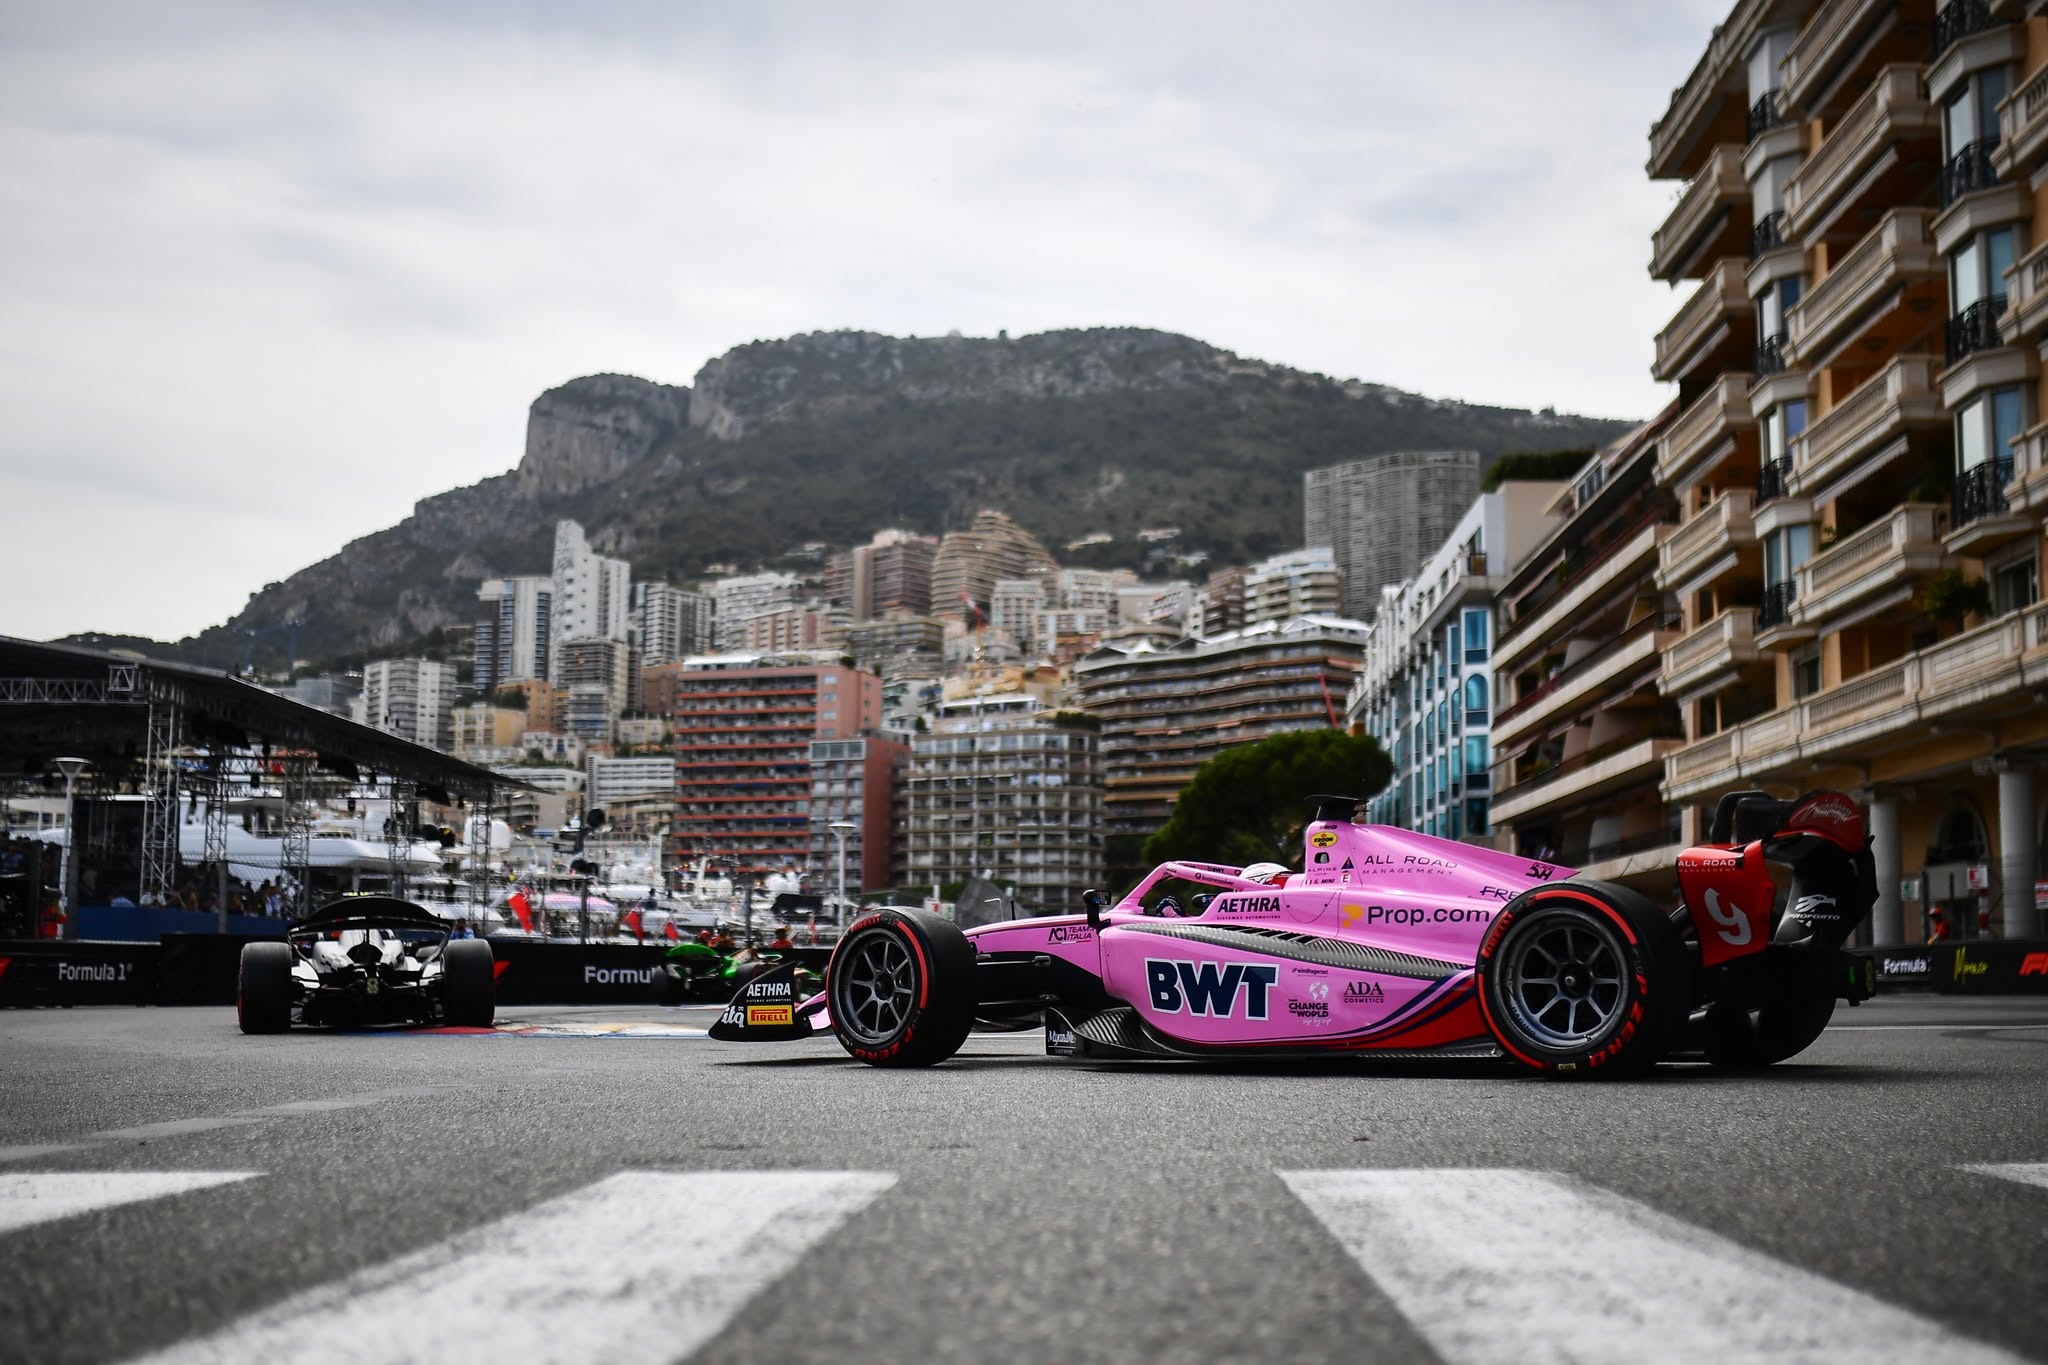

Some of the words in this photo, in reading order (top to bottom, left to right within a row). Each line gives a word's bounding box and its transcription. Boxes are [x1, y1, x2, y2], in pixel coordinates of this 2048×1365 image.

[1364, 855, 1394, 865] ALL
[1404, 856, 1458, 868] ROAD
[1703, 859, 1736, 867] ROAD
[1362, 868, 1453, 876] MANAGEMENT
[1218, 897, 1280, 913] AETHRA
[1368, 906, 1490, 926] Prop.com
[1067, 932, 1092, 941] ITALIA
[58, 962, 115, 981] Formula
[747, 983, 791, 996] AETHRA
[1145, 958, 1280, 1021] BWT
[1344, 982, 1384, 996] ADA
[1288, 1002, 1328, 1010] CHANGE
[751, 1009, 788, 1022] PIRELLI
